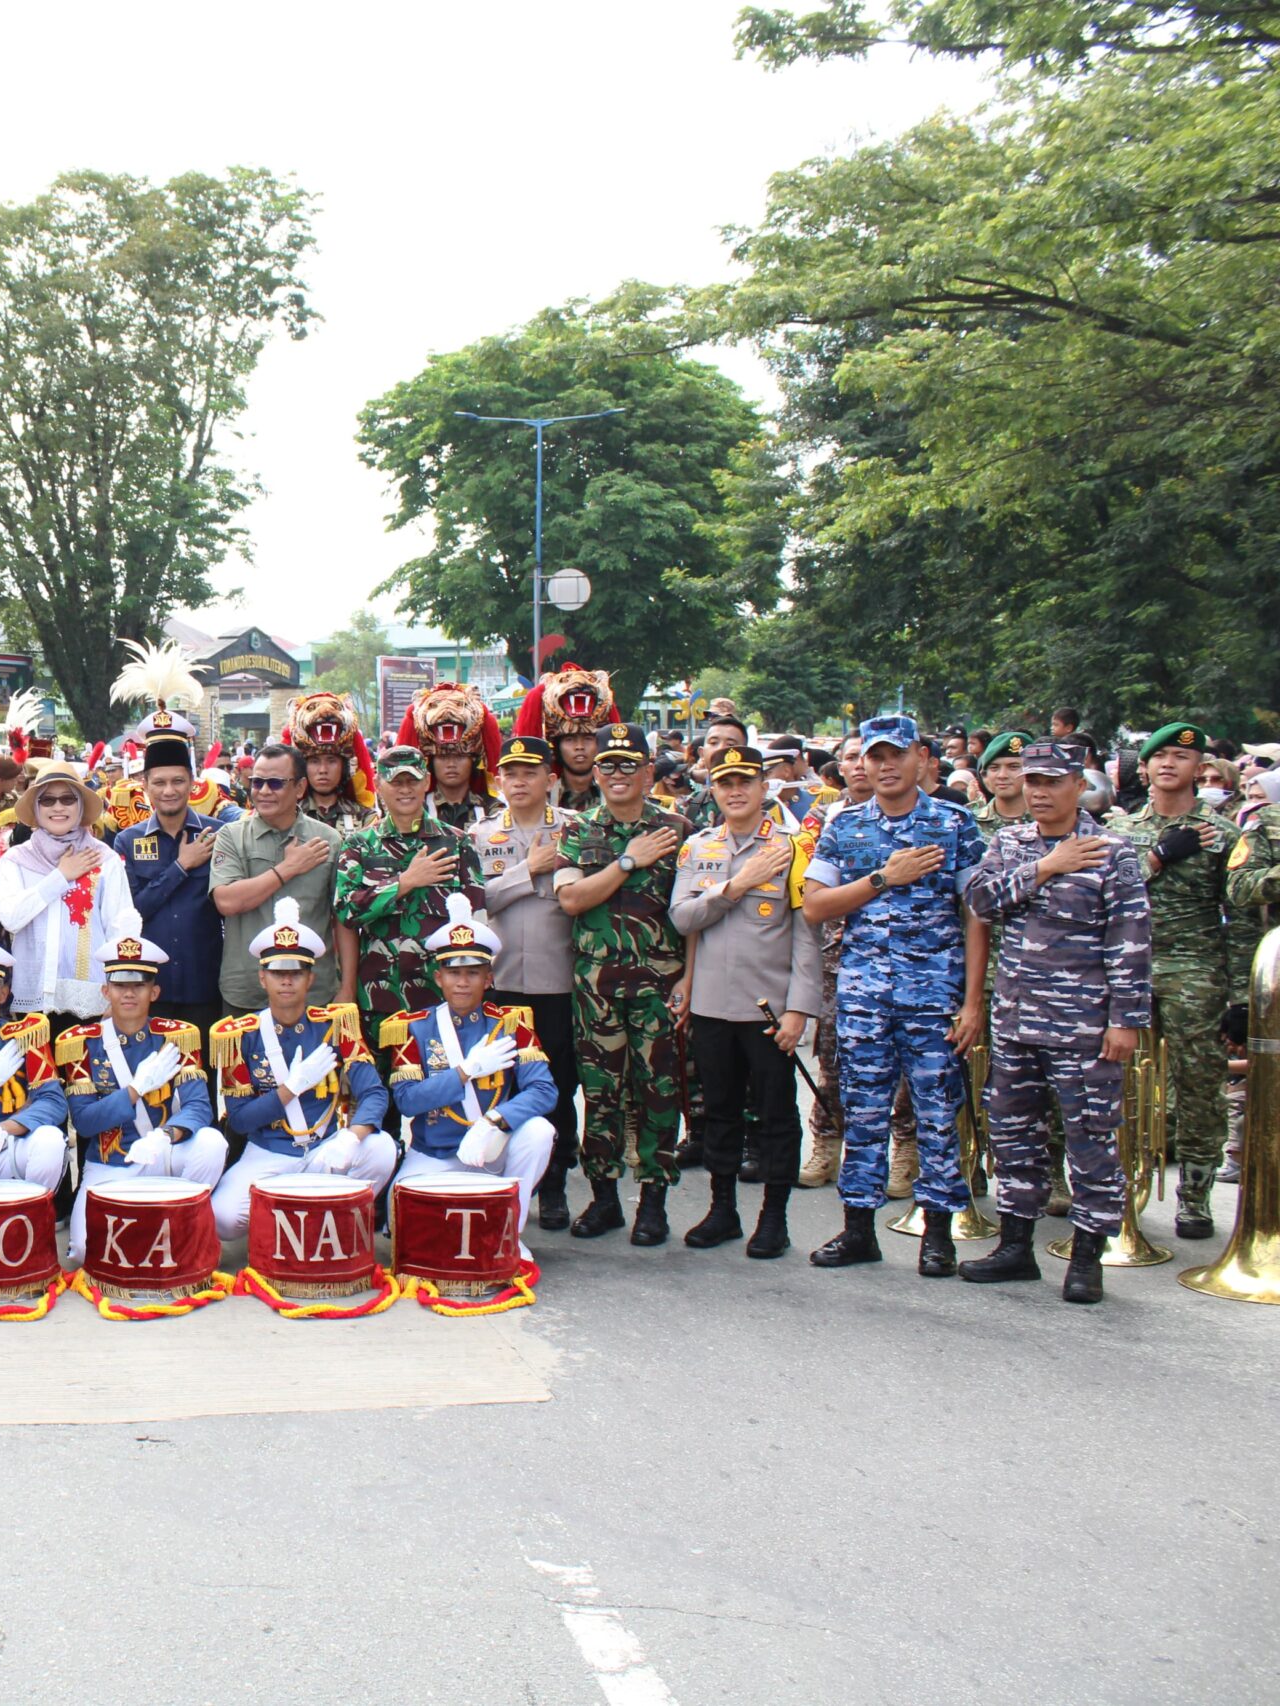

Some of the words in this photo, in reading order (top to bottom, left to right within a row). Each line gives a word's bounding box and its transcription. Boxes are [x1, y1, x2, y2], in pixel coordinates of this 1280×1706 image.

[843, 841, 874, 849] AGUNG
[484, 847, 514, 857] ARI.W
[697, 862, 722, 871] ARY
[100, 1214, 178, 1268] KA
